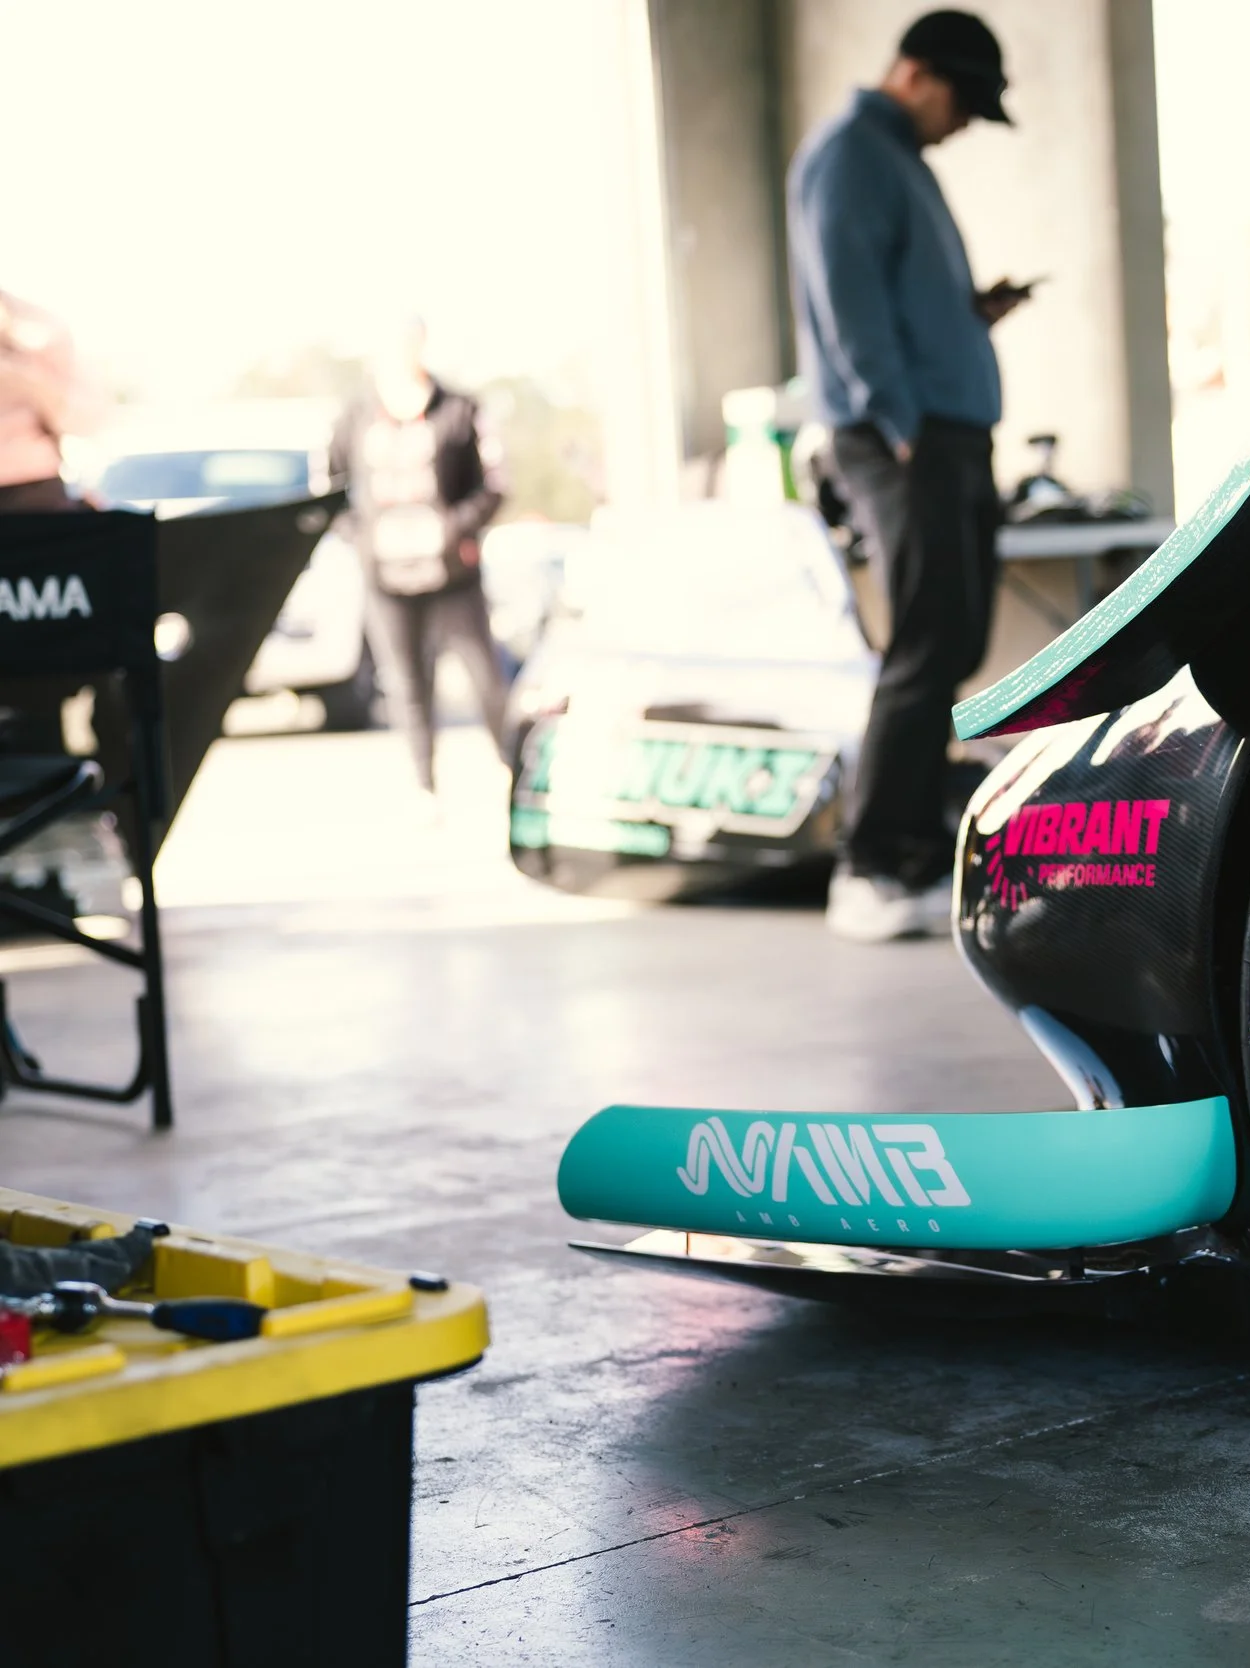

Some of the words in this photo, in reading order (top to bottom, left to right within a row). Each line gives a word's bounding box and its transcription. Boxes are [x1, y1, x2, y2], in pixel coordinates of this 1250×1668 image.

[1003, 799, 1171, 856] VIBRANT
[1038, 863, 1157, 888] PERFORMANCE
[736, 1210, 800, 1228] AMB
[840, 1217, 941, 1233] AERO
